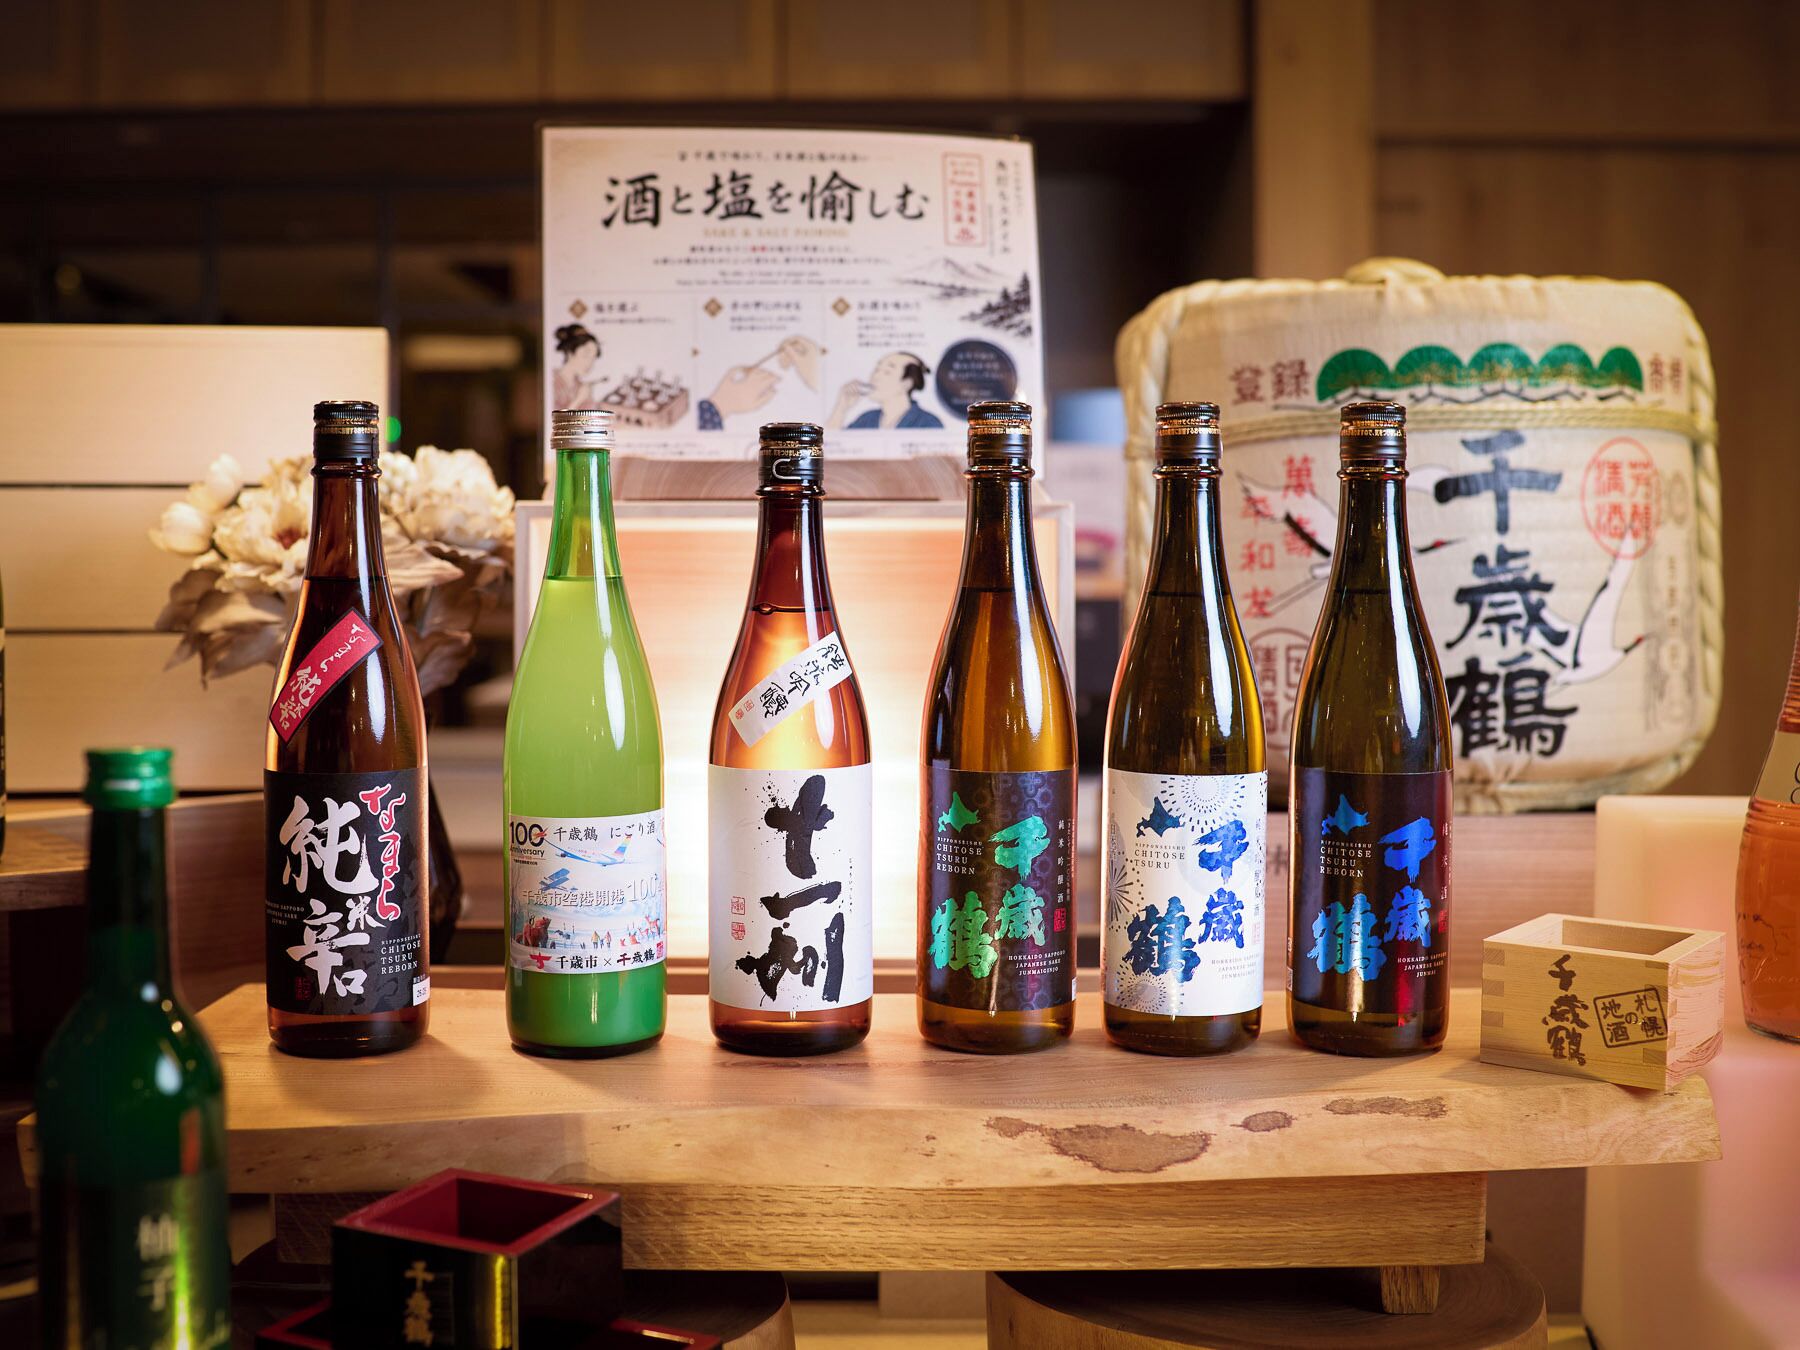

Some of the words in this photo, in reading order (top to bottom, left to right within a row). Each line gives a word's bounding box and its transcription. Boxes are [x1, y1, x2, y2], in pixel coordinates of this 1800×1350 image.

[601, 169, 930, 229] 酒と塩を愉しむ
[1434, 428, 1578, 758] 千歳鶴
[510, 821, 544, 847] 100
[554, 827, 598, 841] 千歳鶴
[610, 820, 655, 838] にごり酒
[358, 783, 407, 921] なまら
[936, 843, 982, 856] CHITOSE
[1134, 849, 1185, 860] CHITOSE
[1320, 846, 1372, 858] CHITOSE
[936, 852, 968, 865] TSURU
[1134, 859, 1170, 870] TSURU
[1319, 855, 1356, 867] TSURU
[936, 862, 975, 875] REBORN
[1319, 865, 1364, 877] REBORN
[279, 795, 386, 998] 純米辛口
[380, 940, 421, 955] CHITOSE
[380, 952, 413, 965] TSURU
[555, 955, 598, 969] 千歳市
[616, 947, 656, 967] 千歳鶴
[1015, 961, 1047, 969] JAPANESE
[381, 960, 418, 975] REBORN
[1541, 954, 1590, 1067] 千歳鶴
